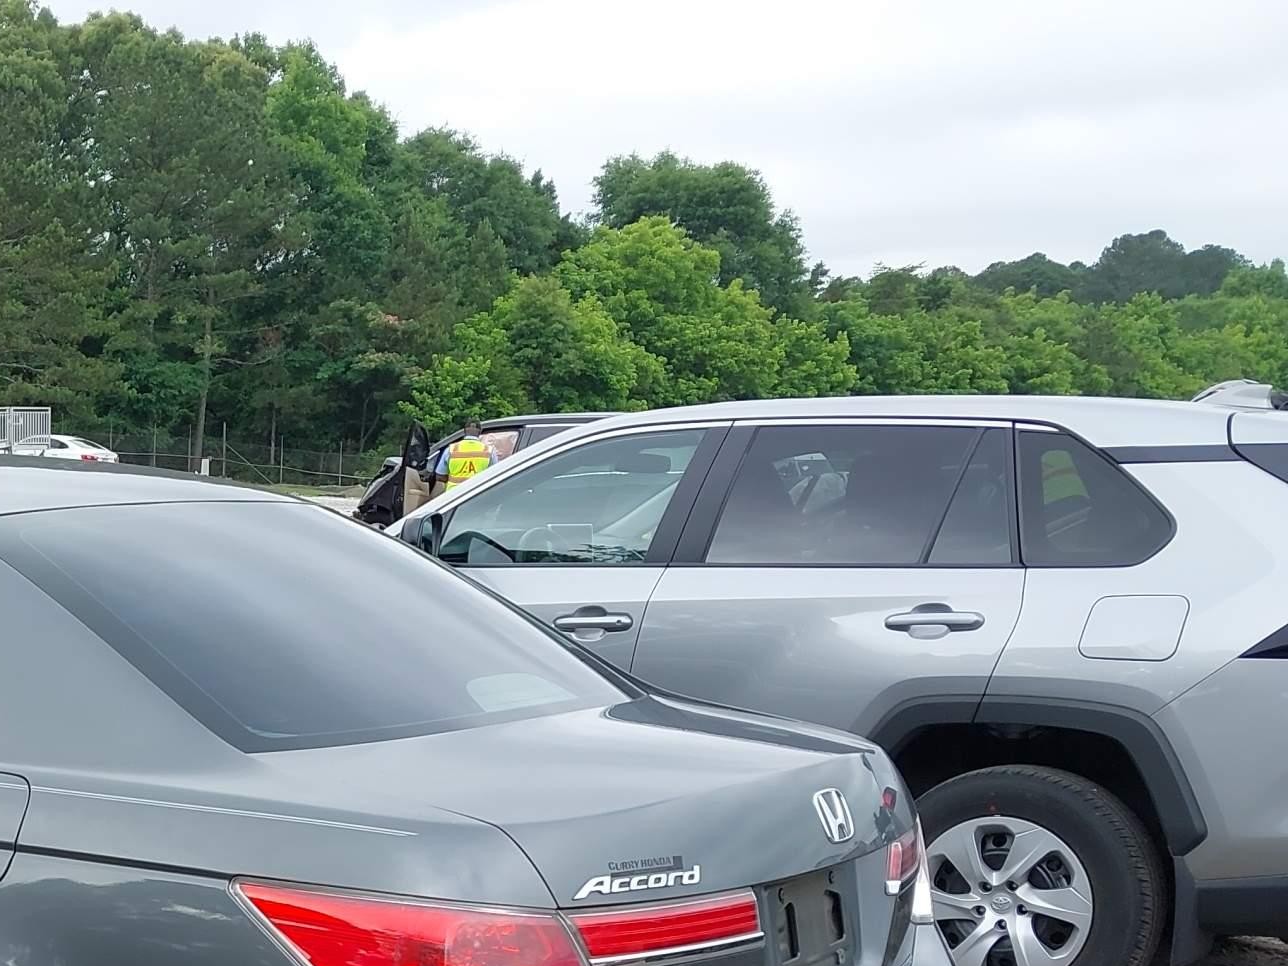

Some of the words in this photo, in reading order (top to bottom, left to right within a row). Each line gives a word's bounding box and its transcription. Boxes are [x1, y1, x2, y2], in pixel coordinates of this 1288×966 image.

[608, 859, 641, 871] CURRY
[641, 856, 672, 867] HONDA
[572, 864, 701, 900] Accord
